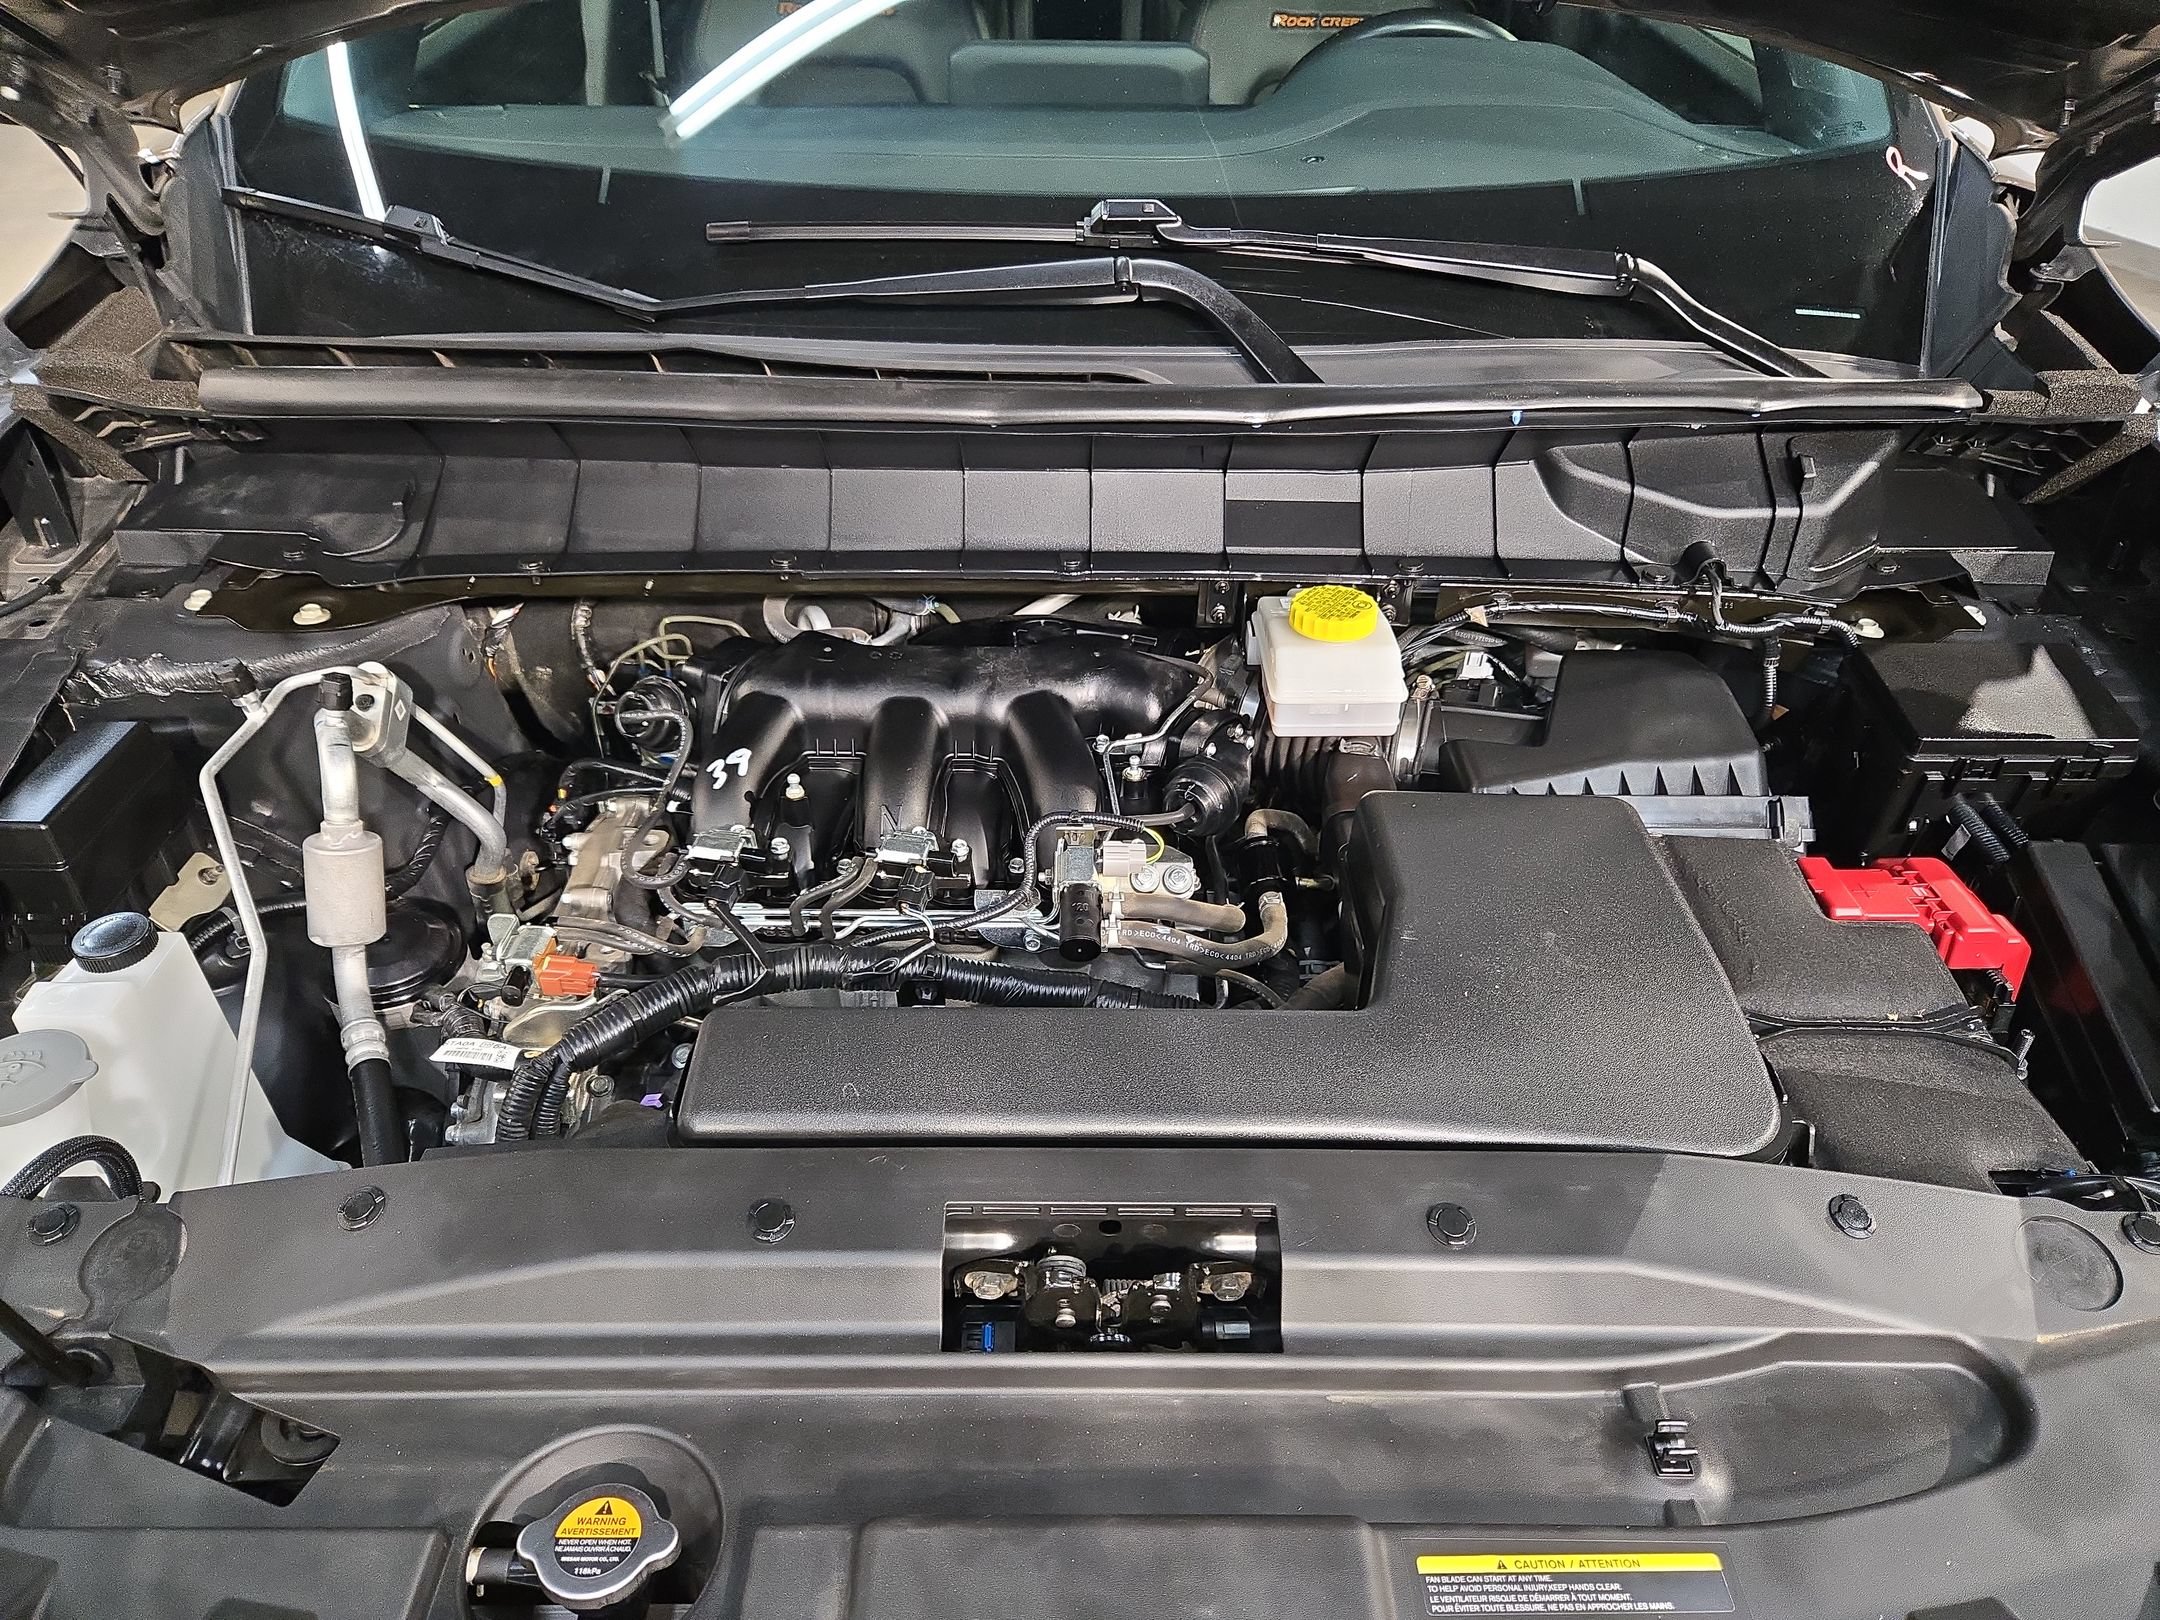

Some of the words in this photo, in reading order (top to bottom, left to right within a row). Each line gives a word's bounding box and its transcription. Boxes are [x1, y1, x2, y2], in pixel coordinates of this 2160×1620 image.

[1272, 14, 1317, 27] ROCK
[1320, 16, 1365, 27] CREE
[705, 747, 752, 790] 39
[577, 1517, 627, 1526] WARNING
[561, 1528, 636, 1536] AVERTISSEMENT
[1514, 1559, 1565, 1569] CAUTION
[1579, 1559, 1641, 1569] ATTENTION
[1529, 1592, 1570, 1601] DÉMARRER
[1432, 1605, 1454, 1613] POUR
[1455, 1603, 1480, 1612] ÉVITER
[1547, 1603, 1559, 1611] NE
[1559, 1603, 1574, 1611] PAS
[1575, 1603, 1586, 1611] EN
[1588, 1602, 1633, 1611] APPROCHER
[1634, 1602, 1648, 1610] LES
